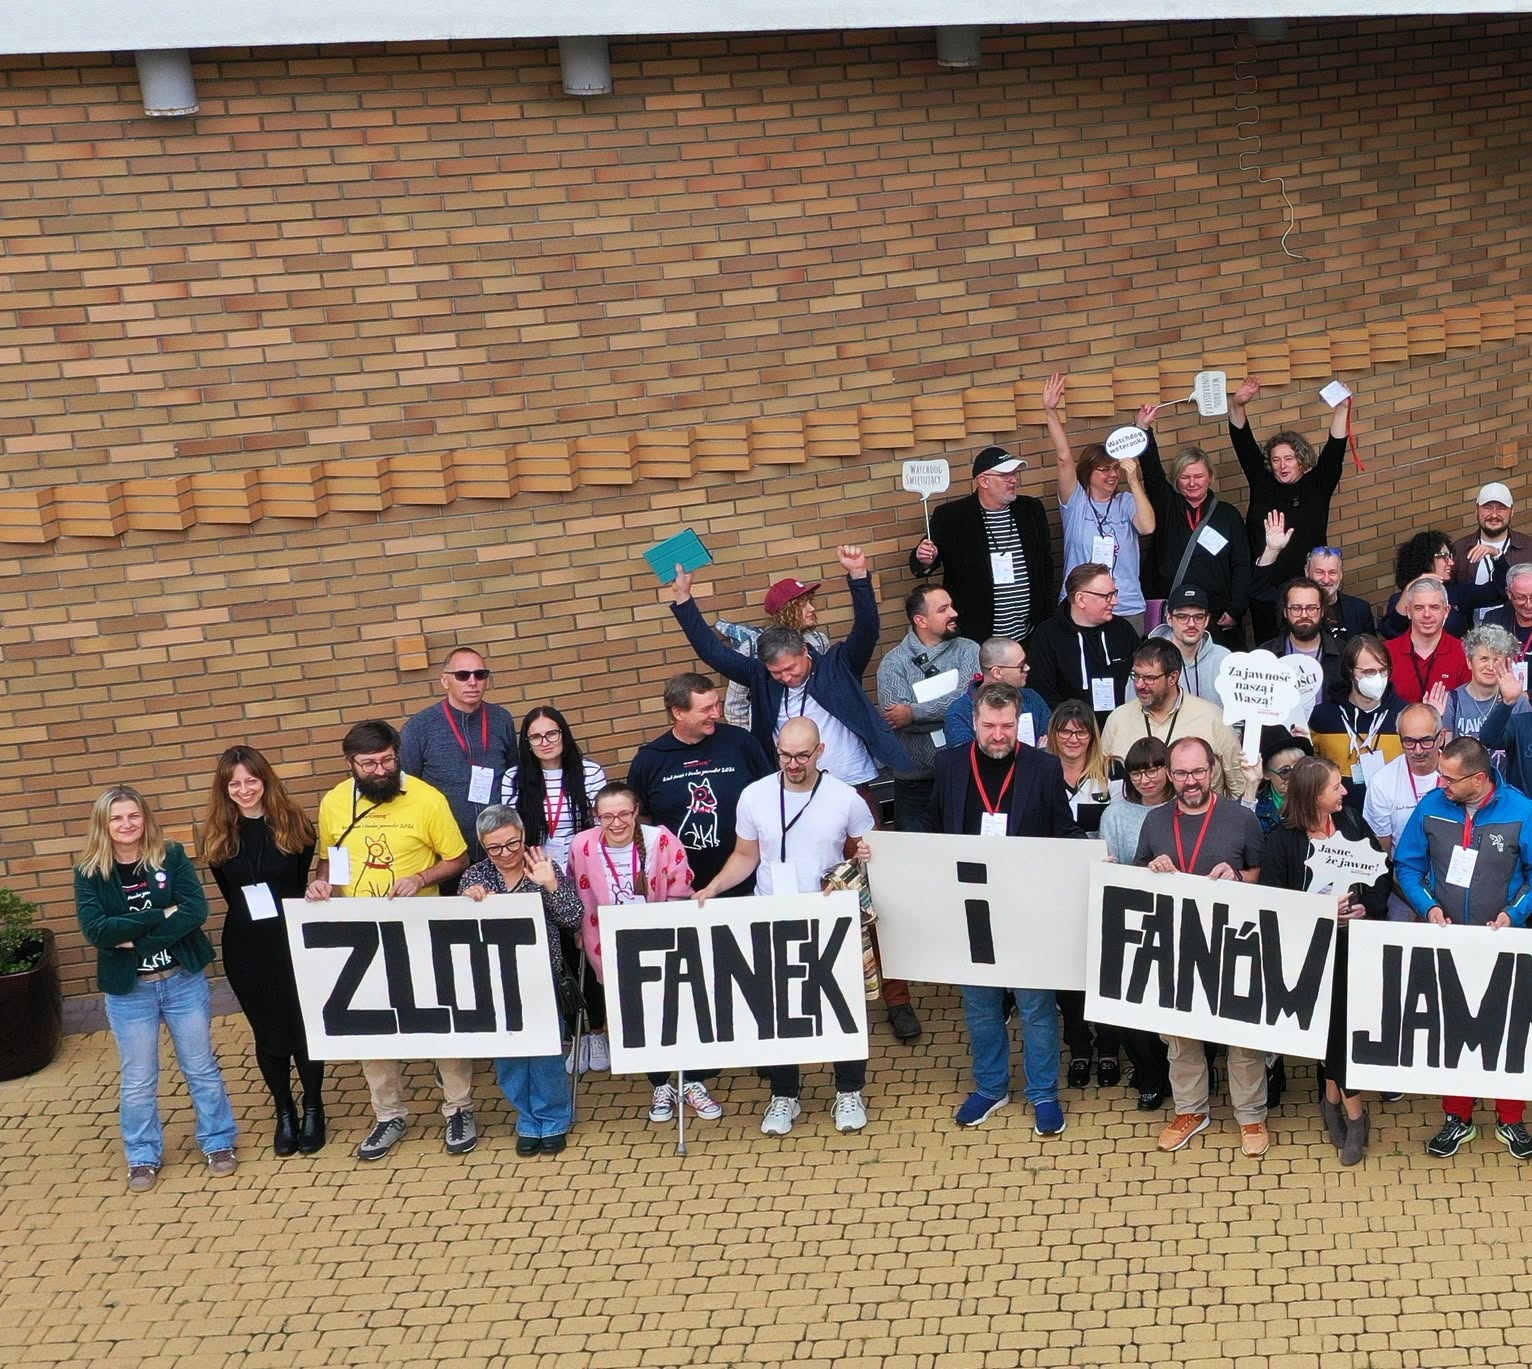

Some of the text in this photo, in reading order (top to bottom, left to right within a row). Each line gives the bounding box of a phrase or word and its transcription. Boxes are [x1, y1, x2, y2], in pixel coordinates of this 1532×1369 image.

[1106, 431, 1144, 448] Watchdog
[1109, 437, 1146, 454] weteranka
[910, 464, 943, 475] WATCHDOG
[1228, 666, 1291, 683] Za jawność
[1235, 681, 1275, 696] naszą i
[1233, 692, 1274, 708] Waszą!
[1318, 844, 1354, 858] Jasne,
[1325, 855, 1338, 865] że
[1337, 857, 1380, 872] jawne!
[302, 918, 536, 1035] ZLOT
[616, 917, 859, 1048] FANEK
[957, 861, 996, 965] i
[1100, 886, 1335, 1031] FANÓW
